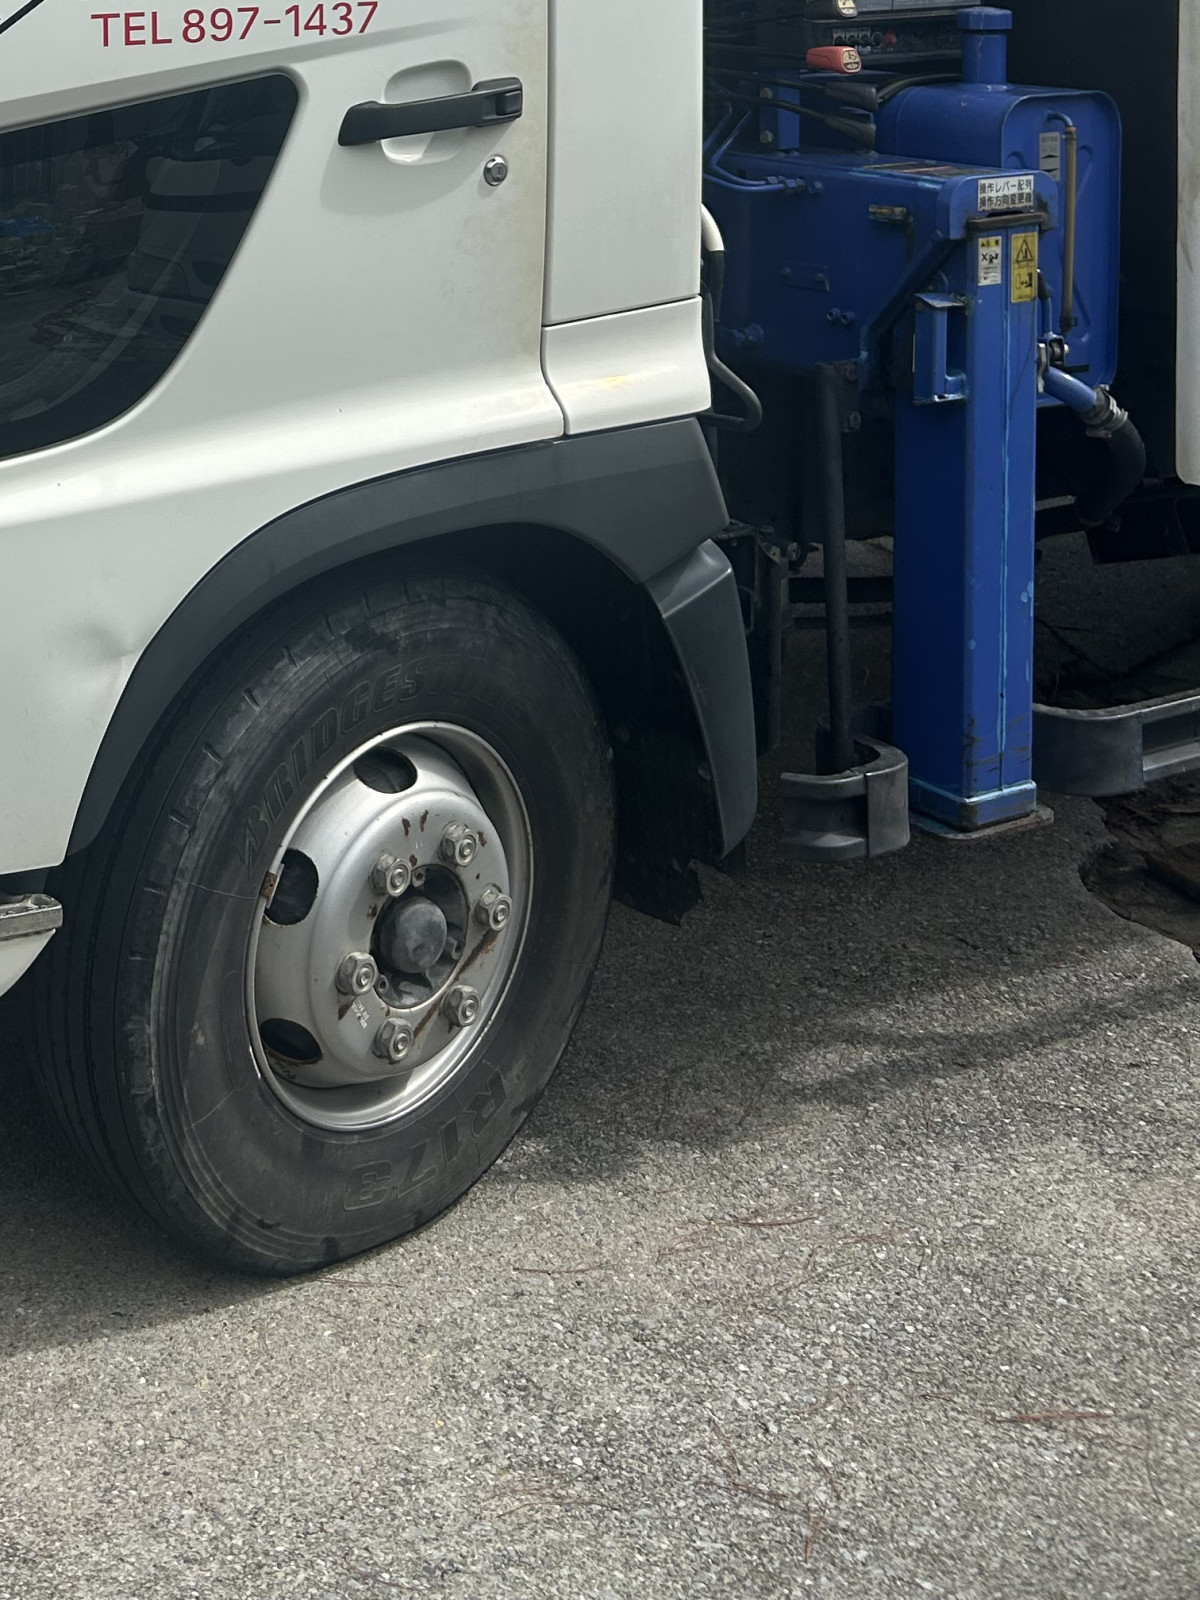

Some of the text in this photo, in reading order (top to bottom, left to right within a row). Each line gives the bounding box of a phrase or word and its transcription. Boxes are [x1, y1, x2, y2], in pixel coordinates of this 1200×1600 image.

[91, 1, 379, 47] TEL 897-1437
[979, 179, 1032, 194] 操作レバー配列
[342, 1060, 508, 1212] R173
